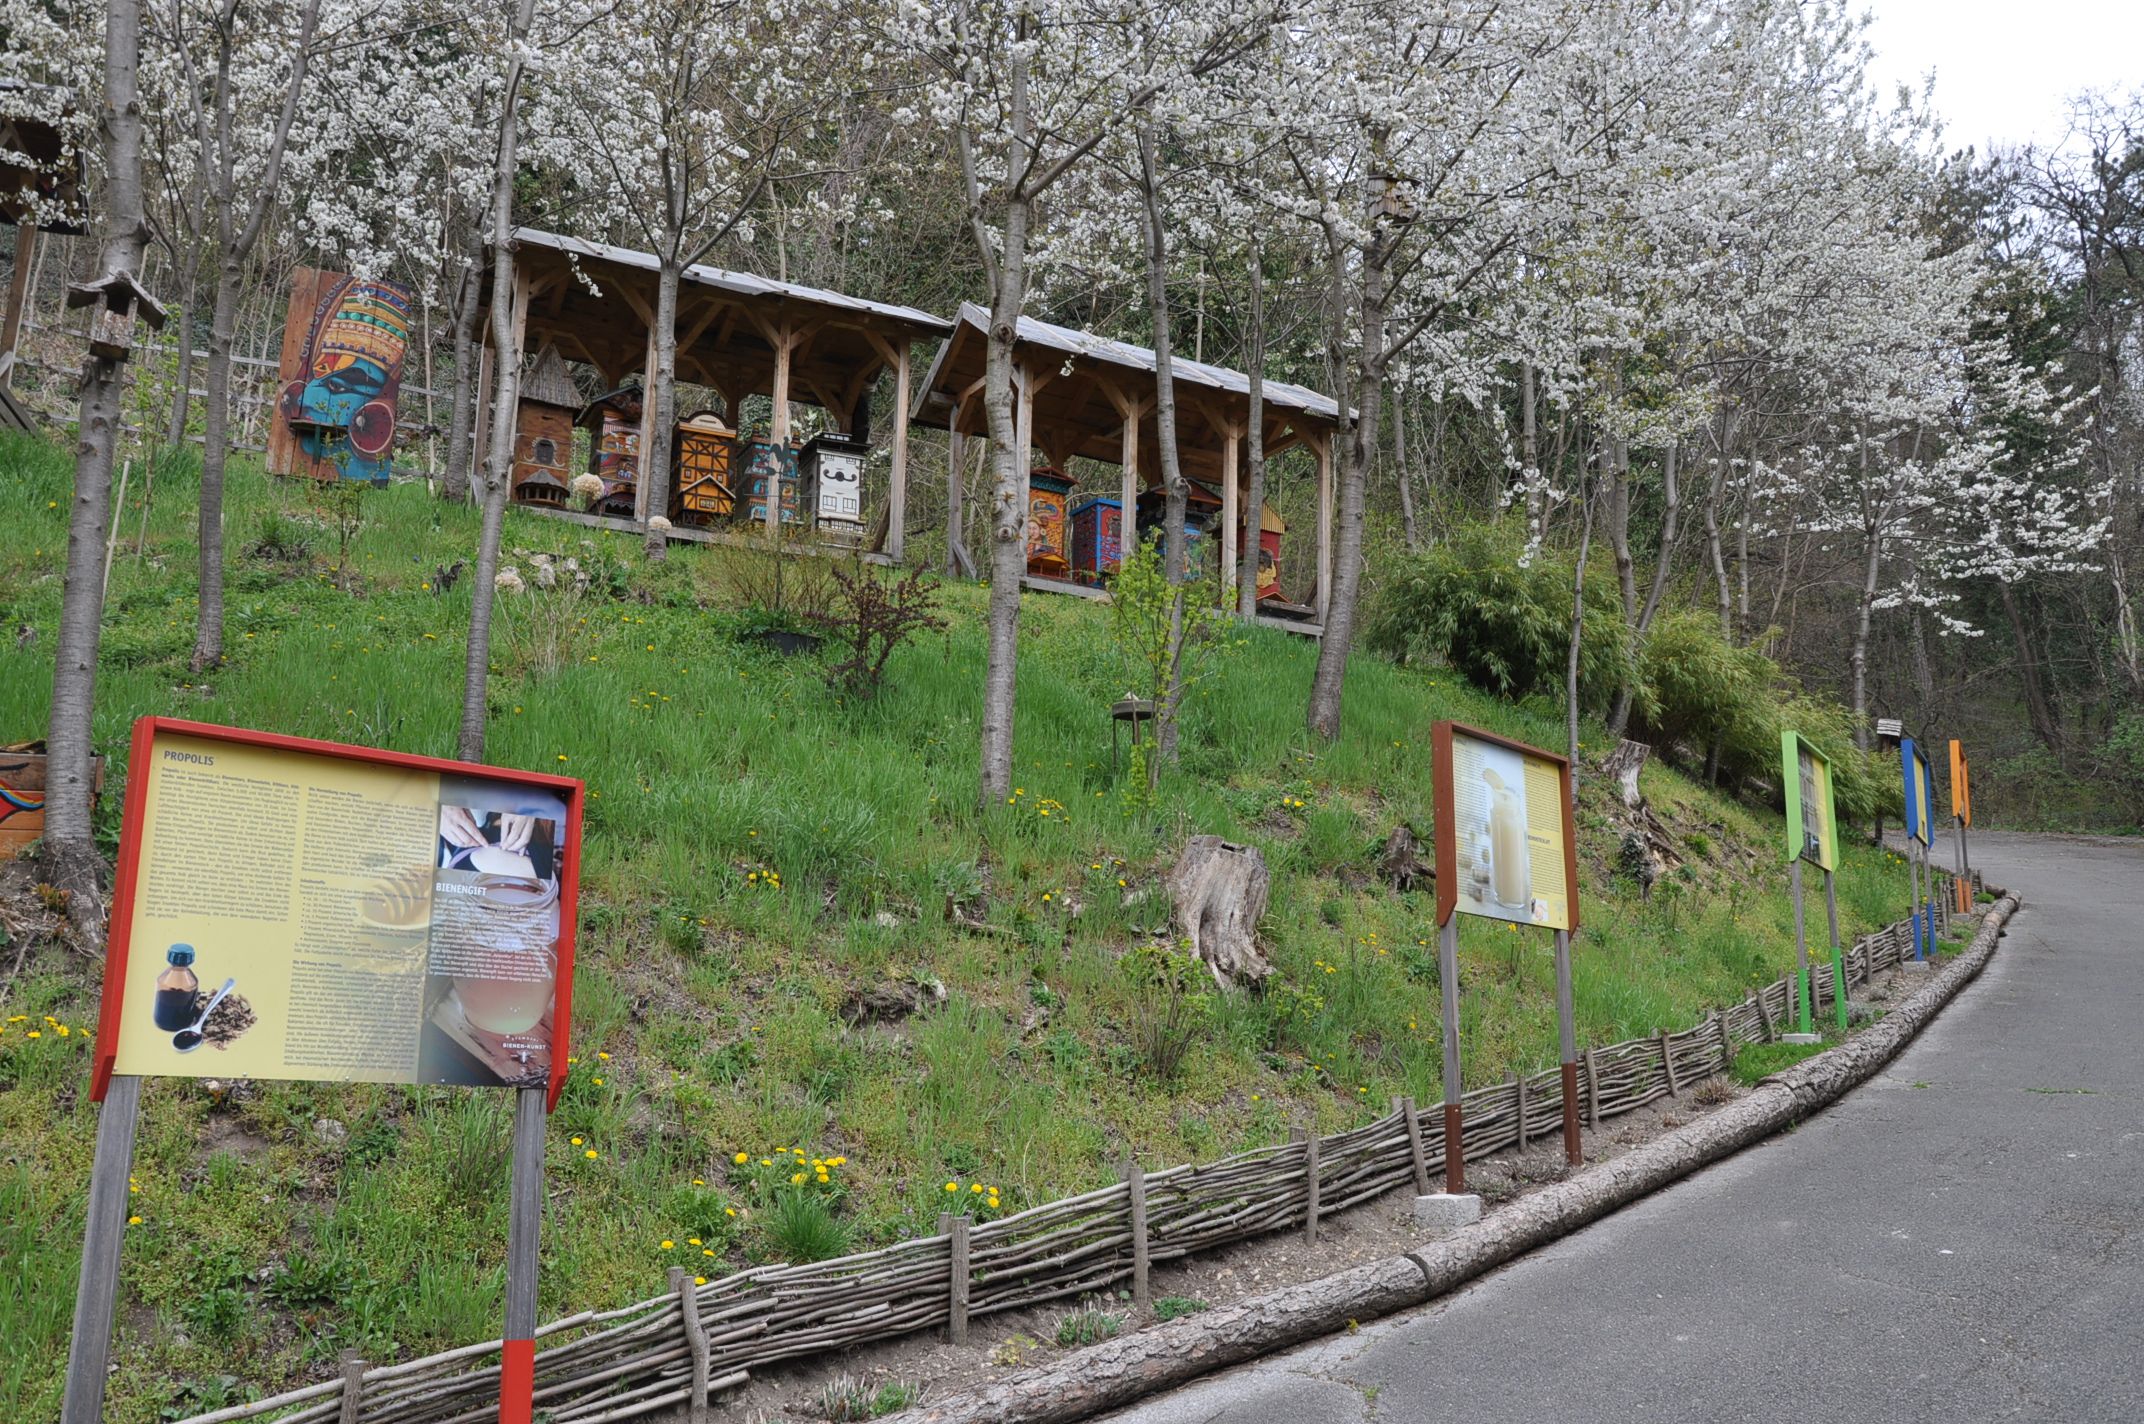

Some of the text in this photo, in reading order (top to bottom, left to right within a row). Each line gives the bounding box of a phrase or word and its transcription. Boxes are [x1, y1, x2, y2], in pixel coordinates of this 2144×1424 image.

[164, 750, 215, 766] PROPOLIS
[435, 882, 487, 896] BIENENGIFT
[502, 1042, 546, 1050] BIENEN-KUNST
